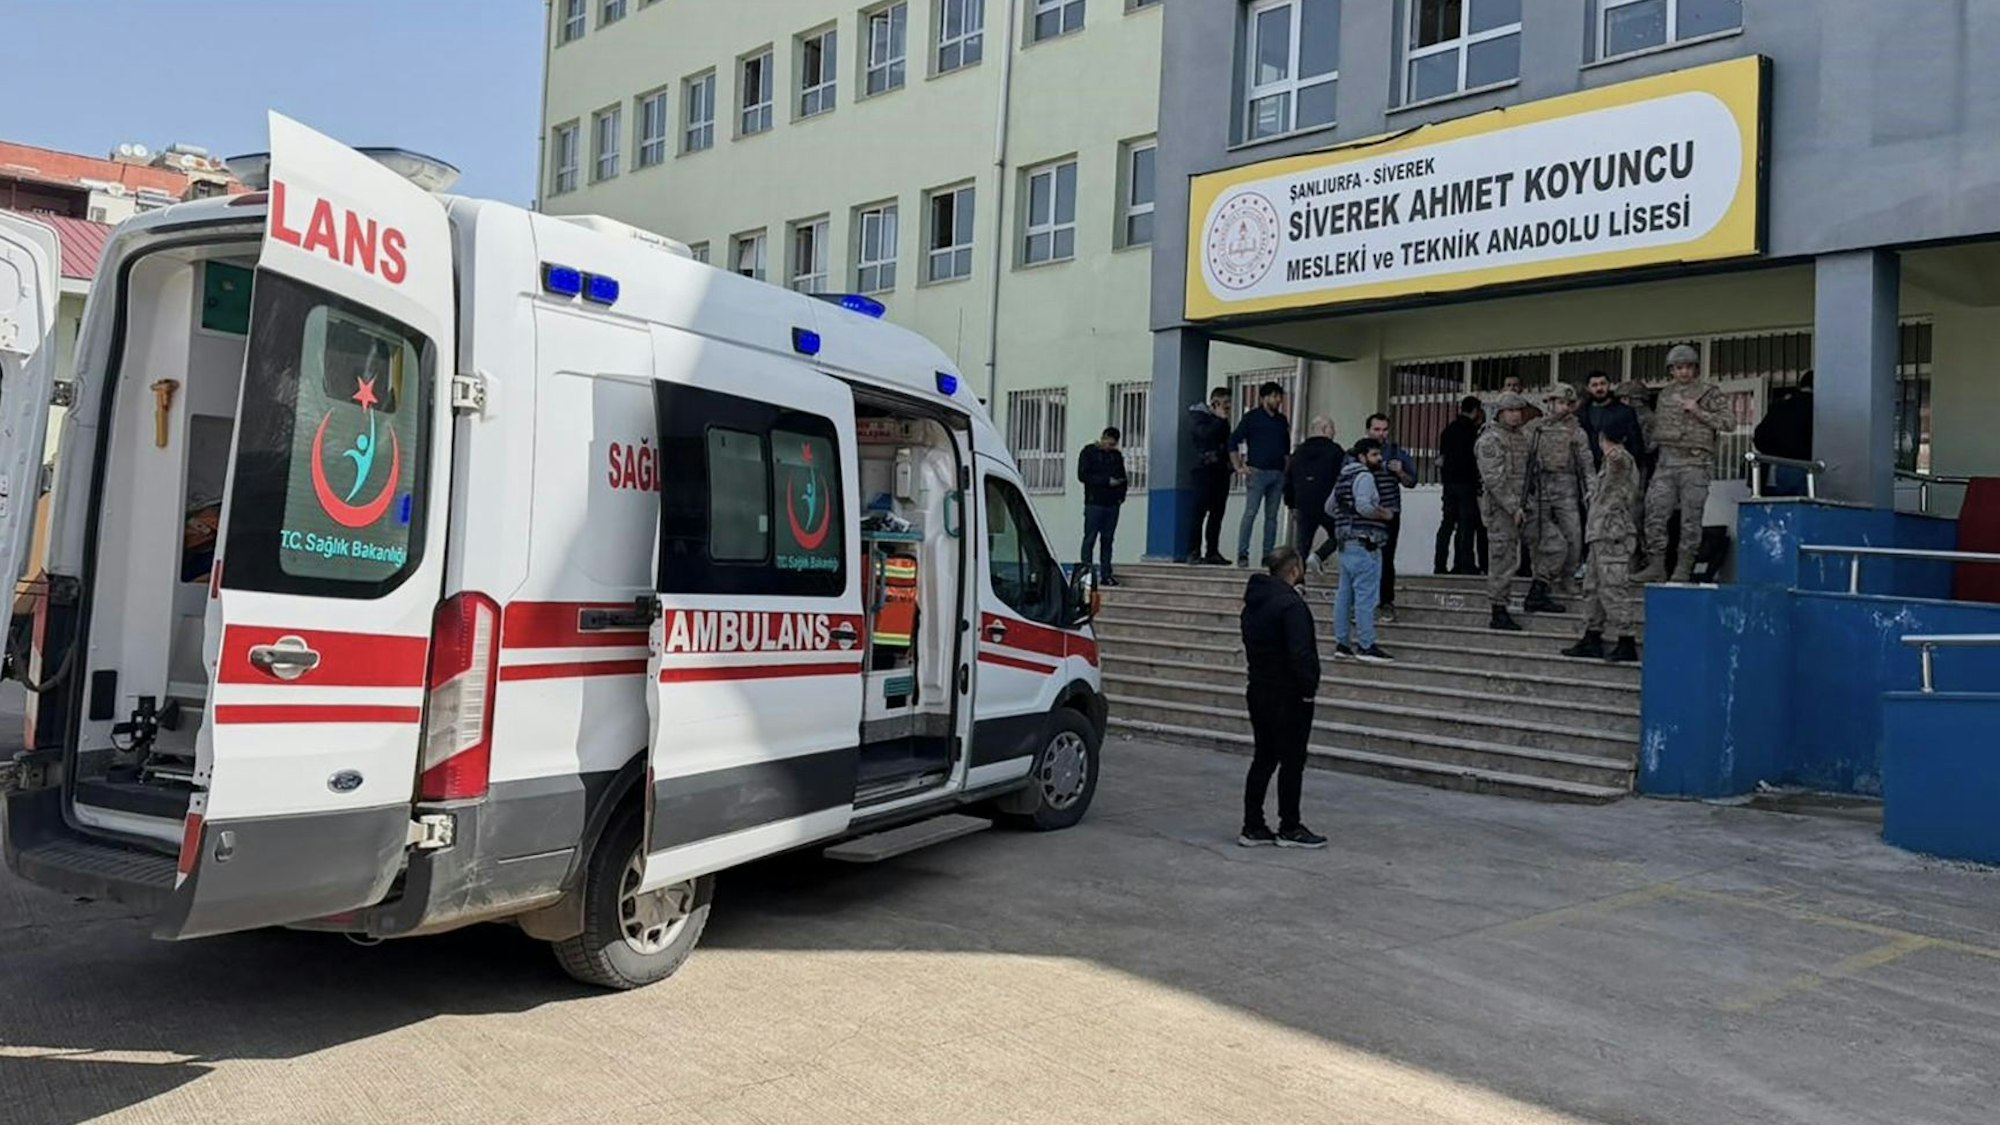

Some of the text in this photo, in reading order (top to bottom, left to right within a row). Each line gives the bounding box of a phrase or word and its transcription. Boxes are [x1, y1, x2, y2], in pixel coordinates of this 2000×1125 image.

[1288, 193, 1401, 242] SİVEREK
[1408, 172, 1514, 223] AHMET
[1524, 140, 1694, 204] KOYUNCU
[1289, 172, 1362, 205] ŞANLIURFA
[1373, 157, 1436, 185] SİVEREK
[270, 179, 407, 285] LANS
[1286, 193, 1691, 282] MESLEKİ ve TEKNİK ANADOLU LİSESİ
[280, 529, 303, 551] T.C.
[304, 532, 349, 559] Sağlık
[666, 610, 831, 653] AMBULANS
